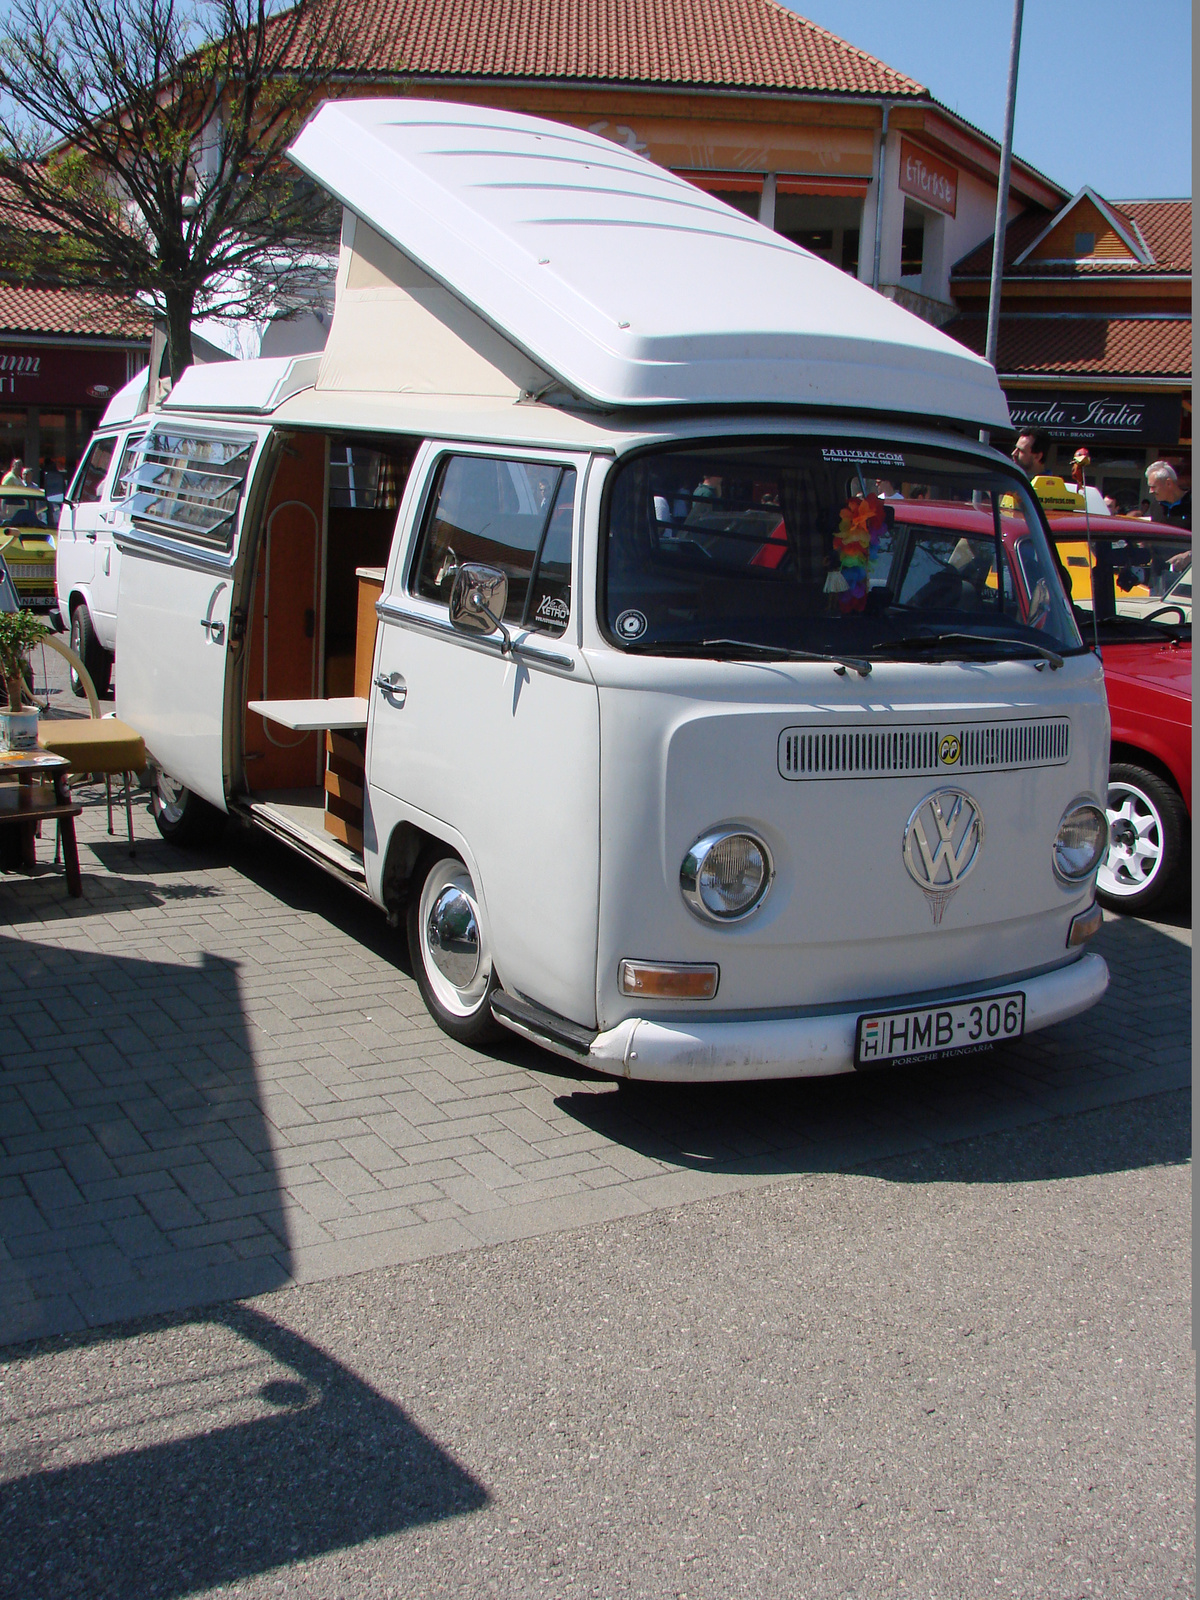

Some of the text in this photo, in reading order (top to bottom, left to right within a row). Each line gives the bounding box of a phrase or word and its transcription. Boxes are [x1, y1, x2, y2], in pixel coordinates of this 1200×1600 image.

[1010, 397, 1142, 426] moda Italia
[821, 448, 904, 461] EARLYBAY.COM
[536, 594, 567, 619] RETRO
[887, 1000, 1018, 1054] HMB-306
[864, 1039, 878, 1057] H
[891, 1042, 995, 1067] PORSCHE HUNGARIA
